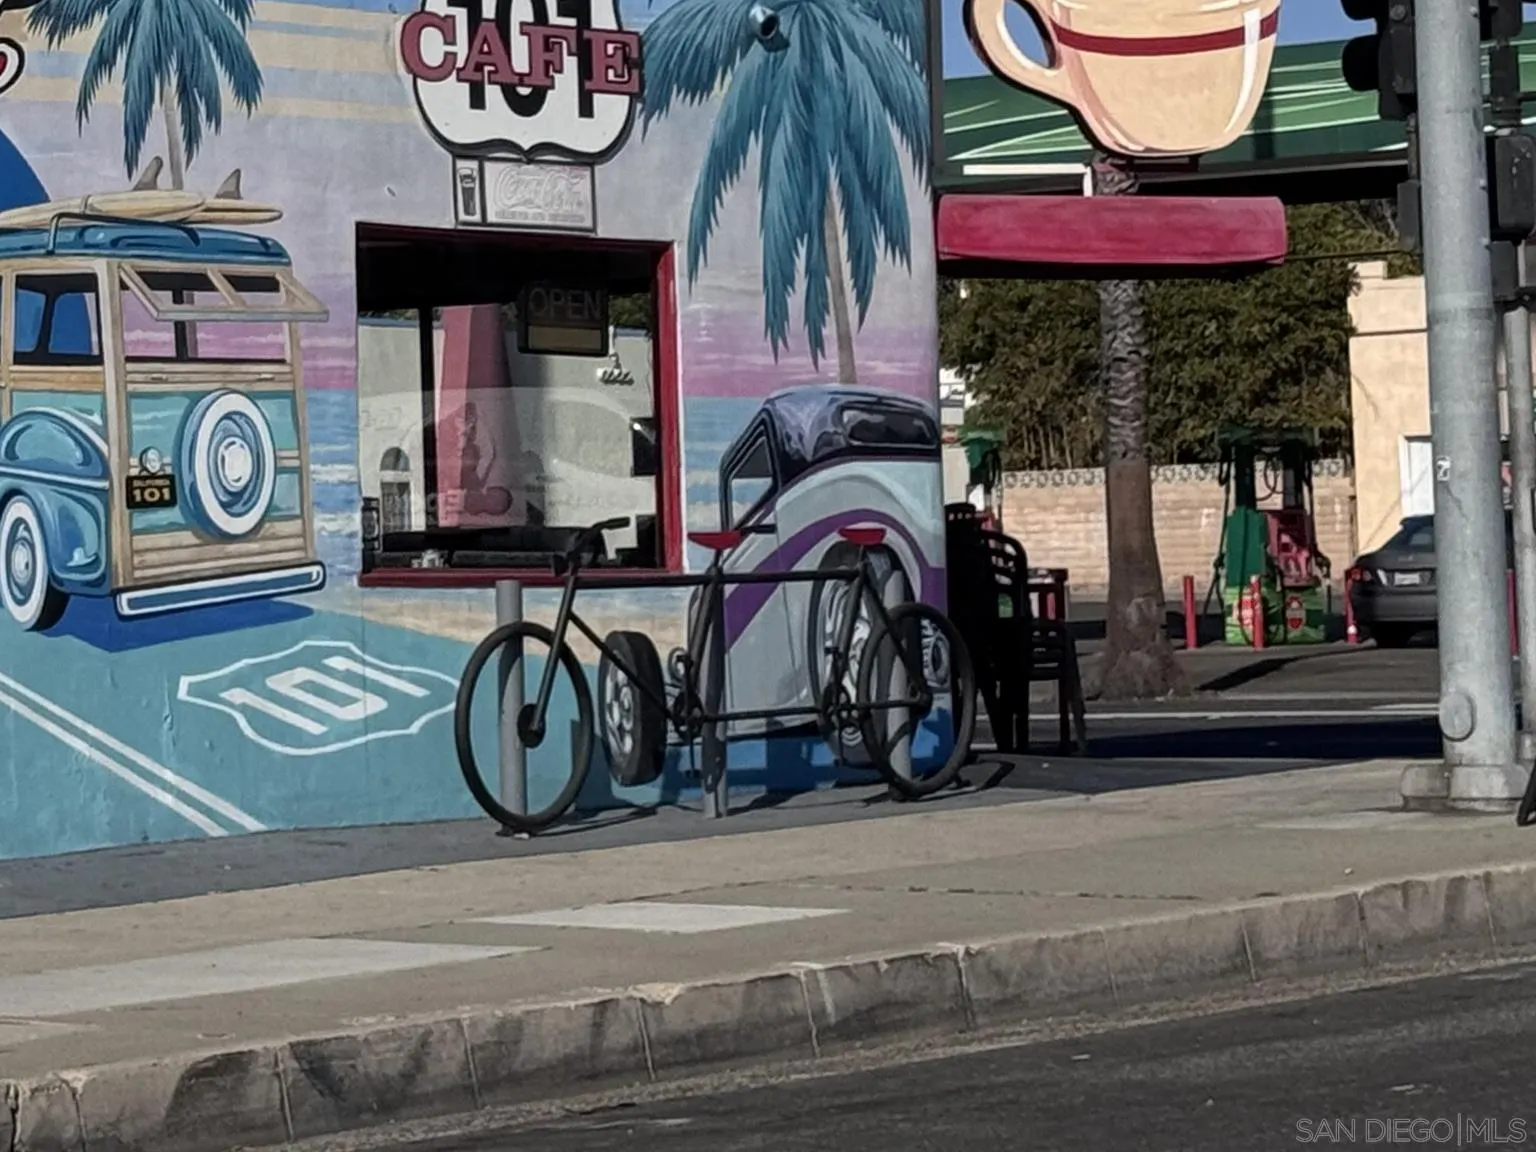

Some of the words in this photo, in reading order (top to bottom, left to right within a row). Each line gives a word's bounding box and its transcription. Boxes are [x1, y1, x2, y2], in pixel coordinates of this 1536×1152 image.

[400, 10, 643, 95] CAFE
[529, 288, 602, 318] OPEN
[132, 487, 171, 502] 101
[219, 656, 431, 735] 101
